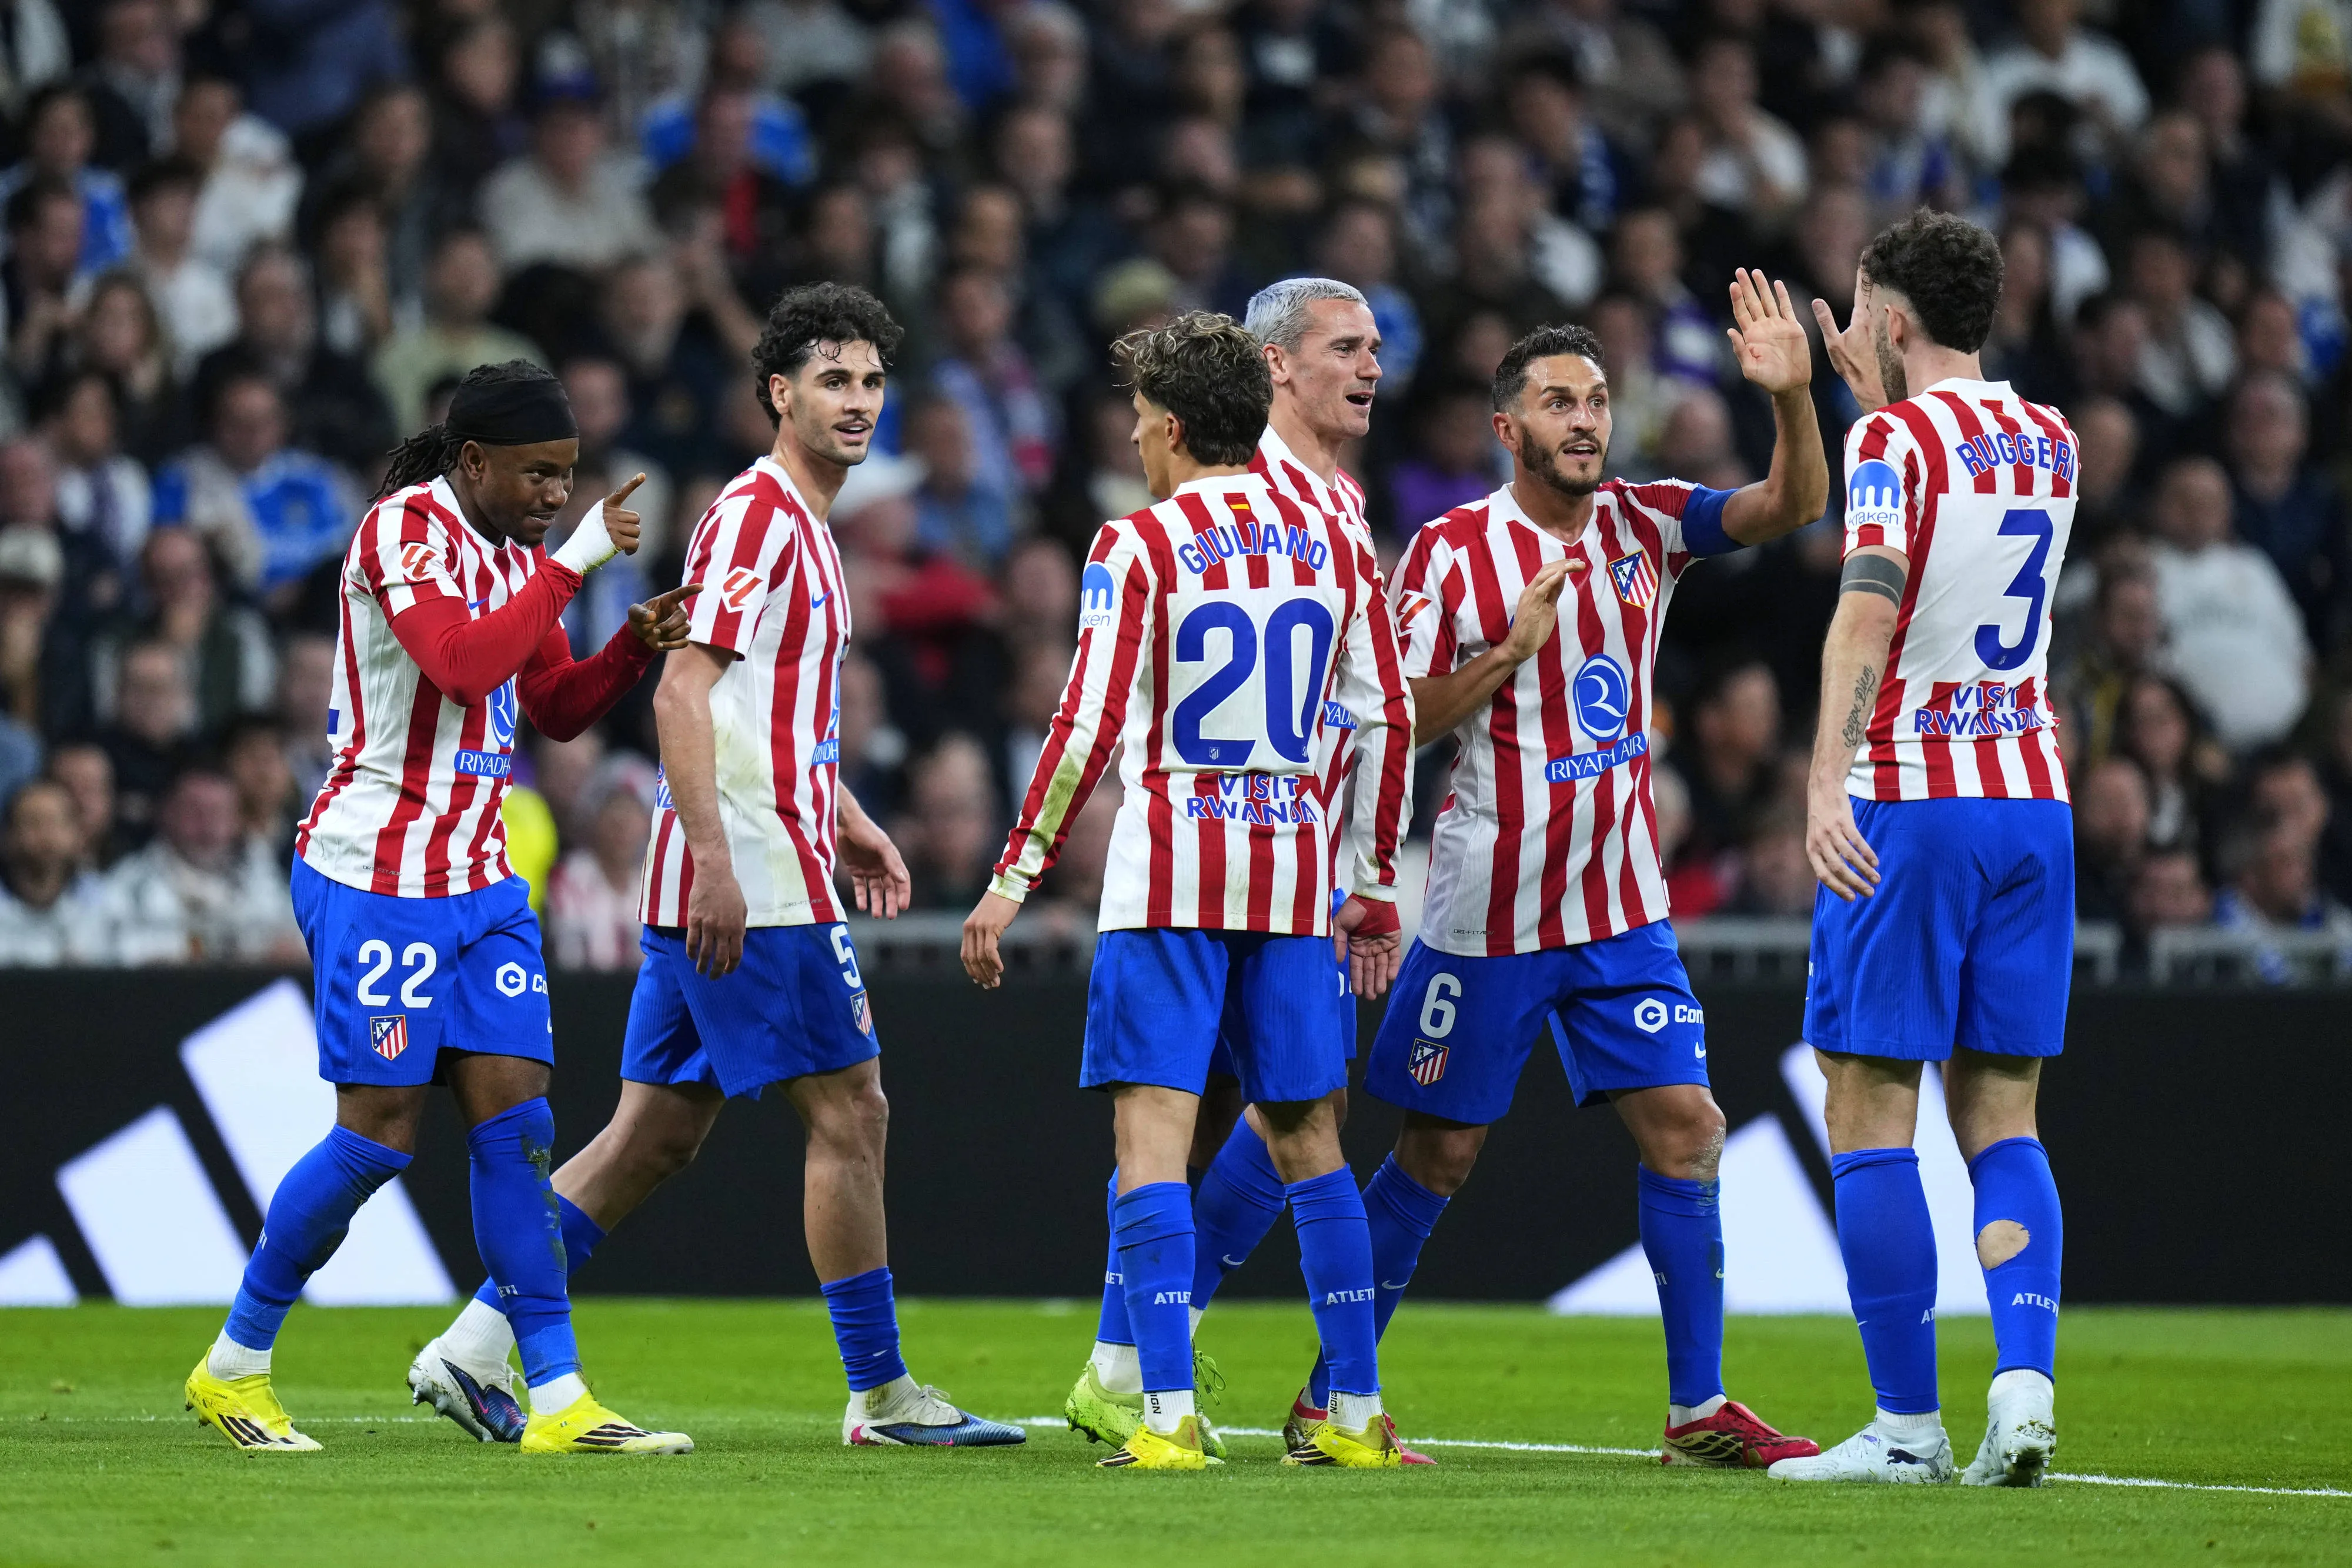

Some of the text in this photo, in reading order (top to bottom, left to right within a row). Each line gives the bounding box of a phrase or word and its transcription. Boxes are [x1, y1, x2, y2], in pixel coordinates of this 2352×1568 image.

[1955, 432, 2075, 483] RUGGERI
[1847, 511, 1899, 527] kraken
[1178, 522, 1327, 575] GIULIANO
[1974, 509, 2054, 671] 3
[1172, 597, 1334, 766] 20
[1954, 685, 2020, 710] VISIT
[1325, 704, 1355, 727] YAD
[1914, 704, 2047, 735] RWANDA
[1621, 735, 1645, 761] AIR
[1218, 773, 1299, 800] VISIT
[1187, 795, 1319, 825] RWANDA
[829, 924, 862, 988] 5
[357, 940, 437, 1009] 22
[532, 974, 549, 996] Co
[1419, 972, 1462, 1038] 6
[1327, 1288, 1375, 1305] ATLETI
[2012, 1292, 2059, 1318] ATLETI
[1150, 1391, 1162, 1415] IGN
